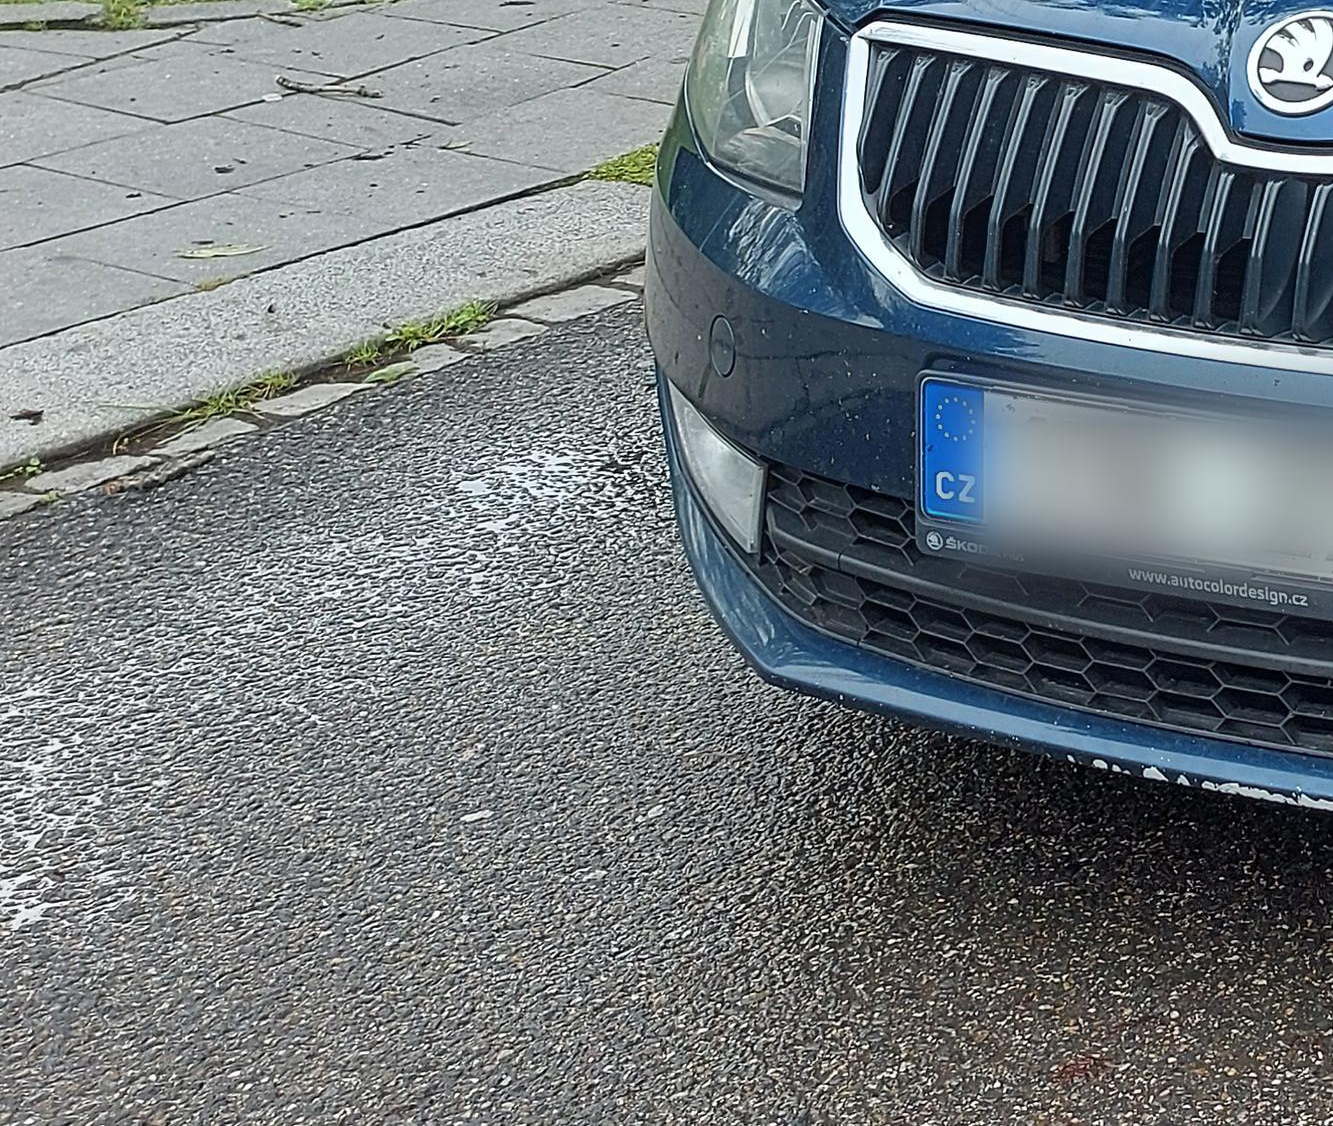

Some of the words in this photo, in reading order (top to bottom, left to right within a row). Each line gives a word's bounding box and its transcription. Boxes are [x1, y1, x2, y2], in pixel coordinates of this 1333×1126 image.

[936, 471, 976, 504] CZ
[945, 536, 1000, 556] ŠKOD
[1128, 568, 1308, 607] www.autocolordesign.cz
